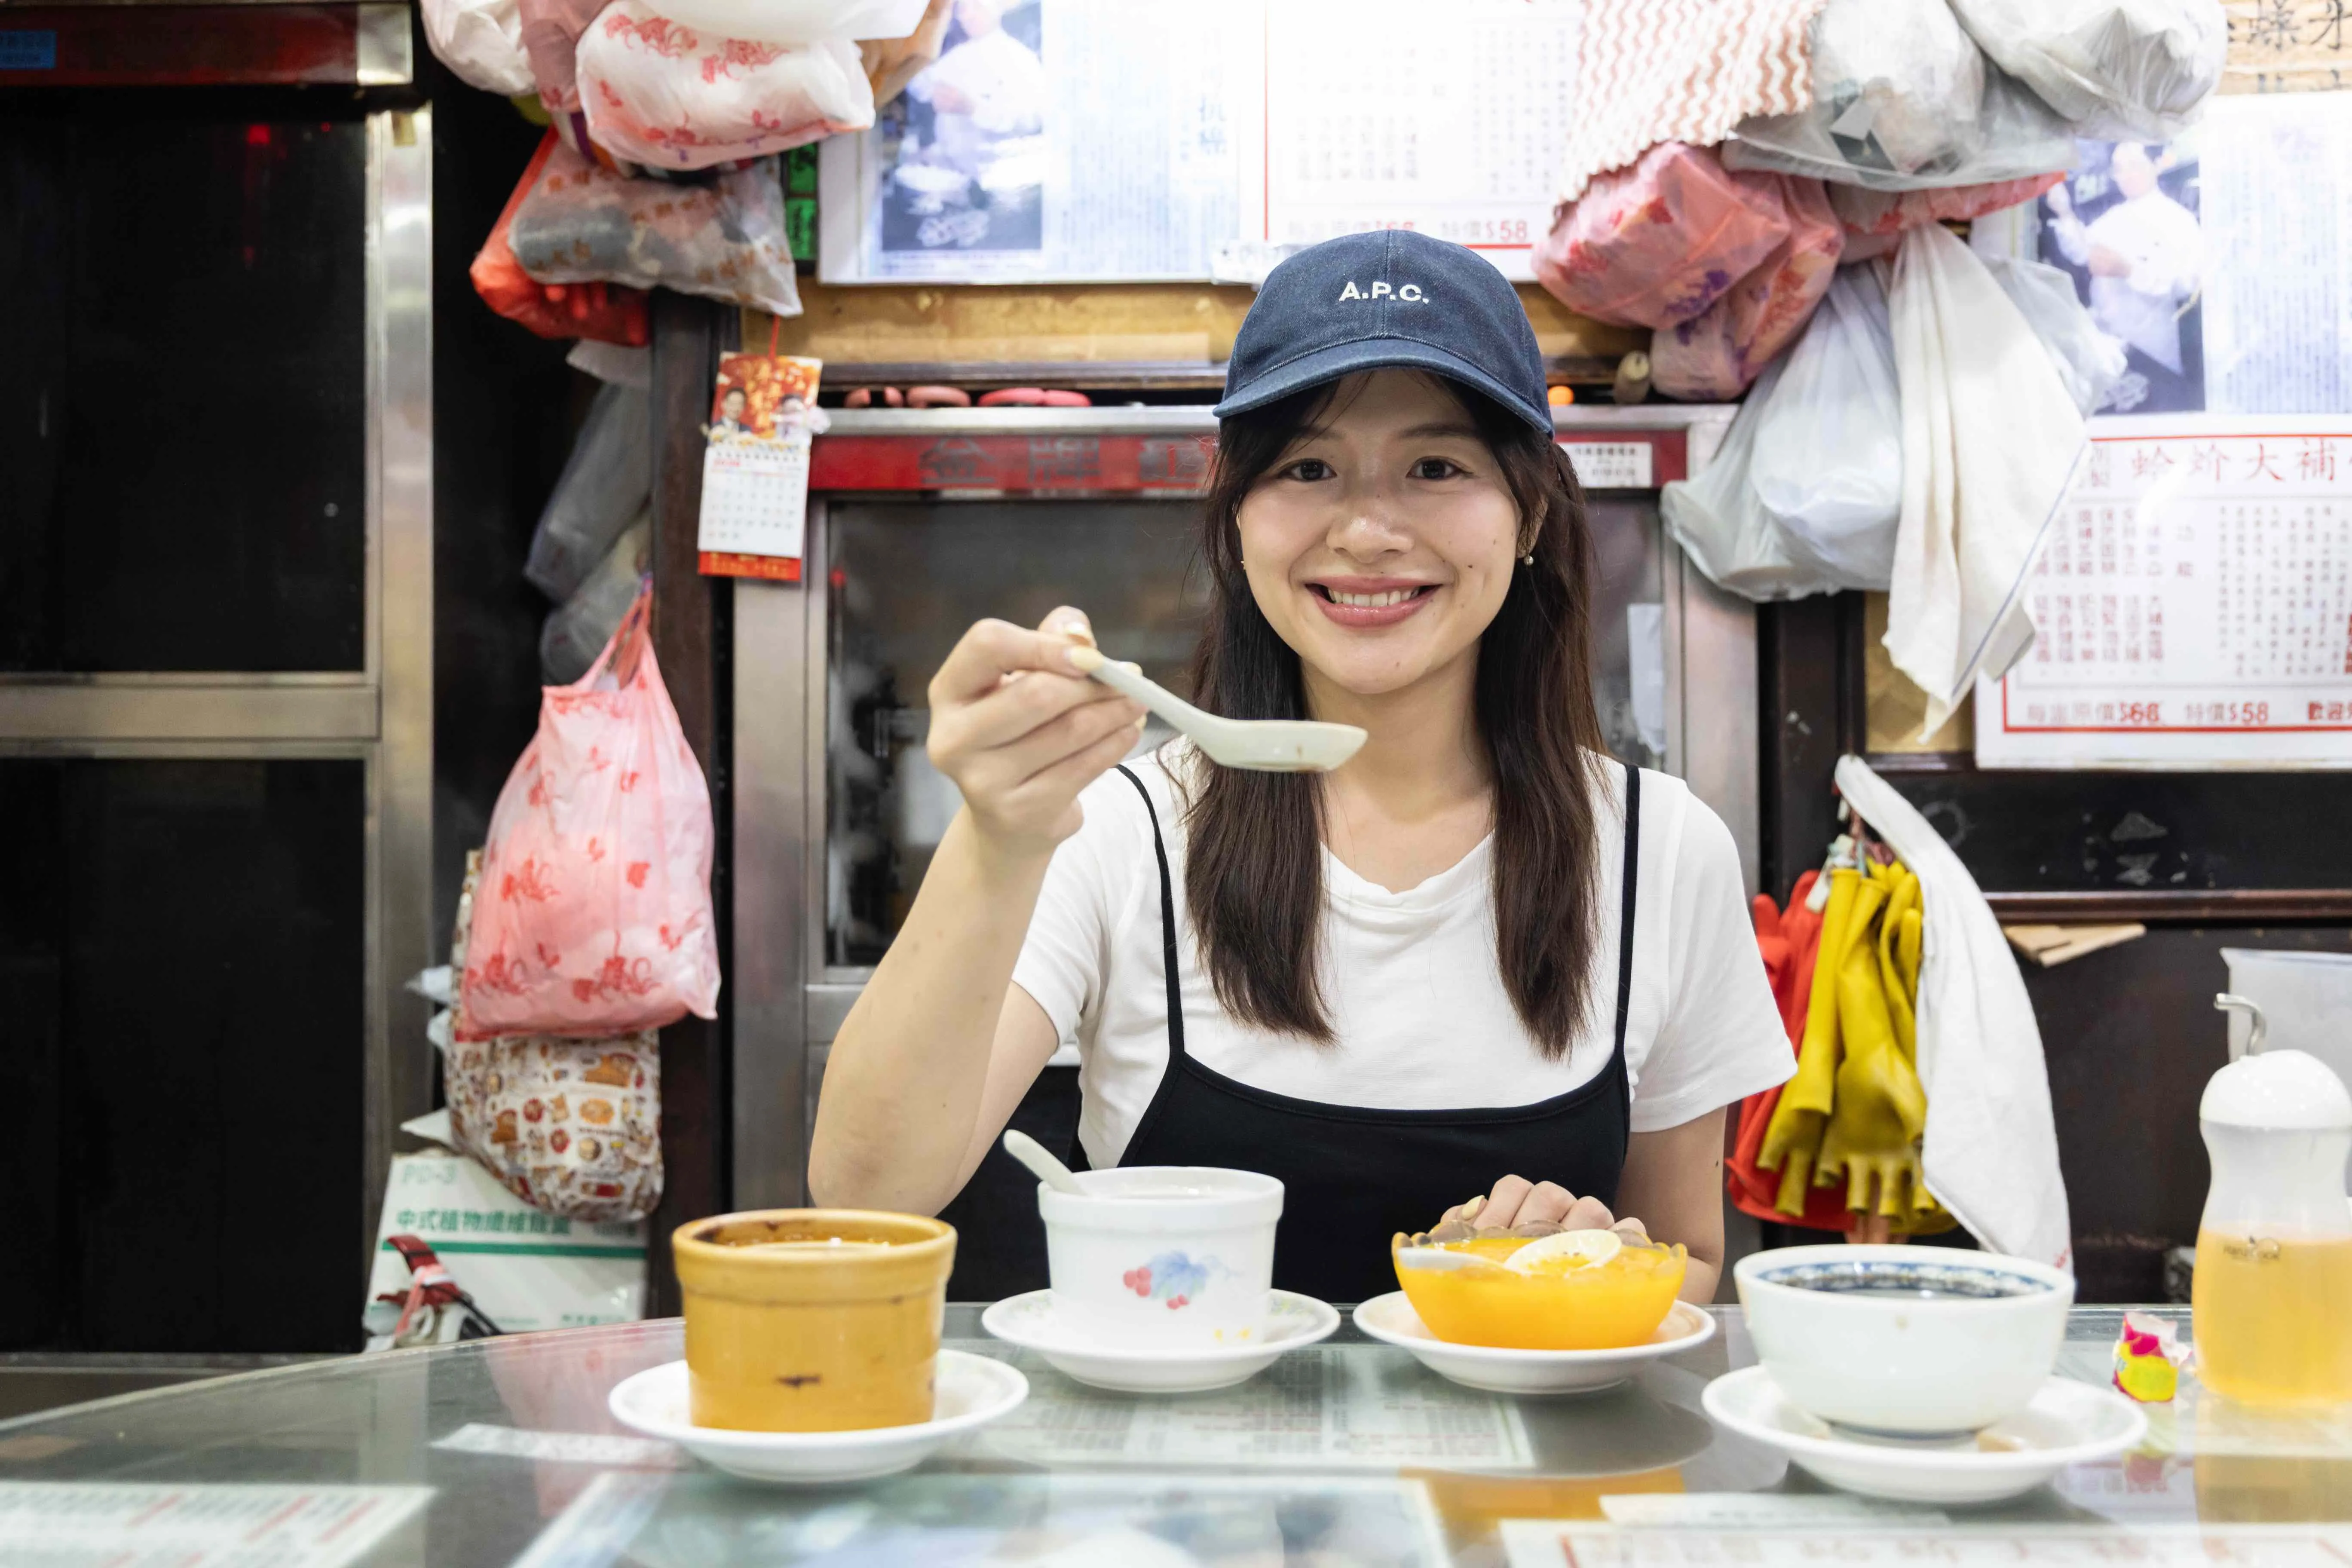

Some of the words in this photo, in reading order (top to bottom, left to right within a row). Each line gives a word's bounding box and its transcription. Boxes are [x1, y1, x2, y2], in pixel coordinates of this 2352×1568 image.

[1338, 281, 1430, 305] A.P.C.
[2131, 438, 2352, 482] 蛤蚧大補
